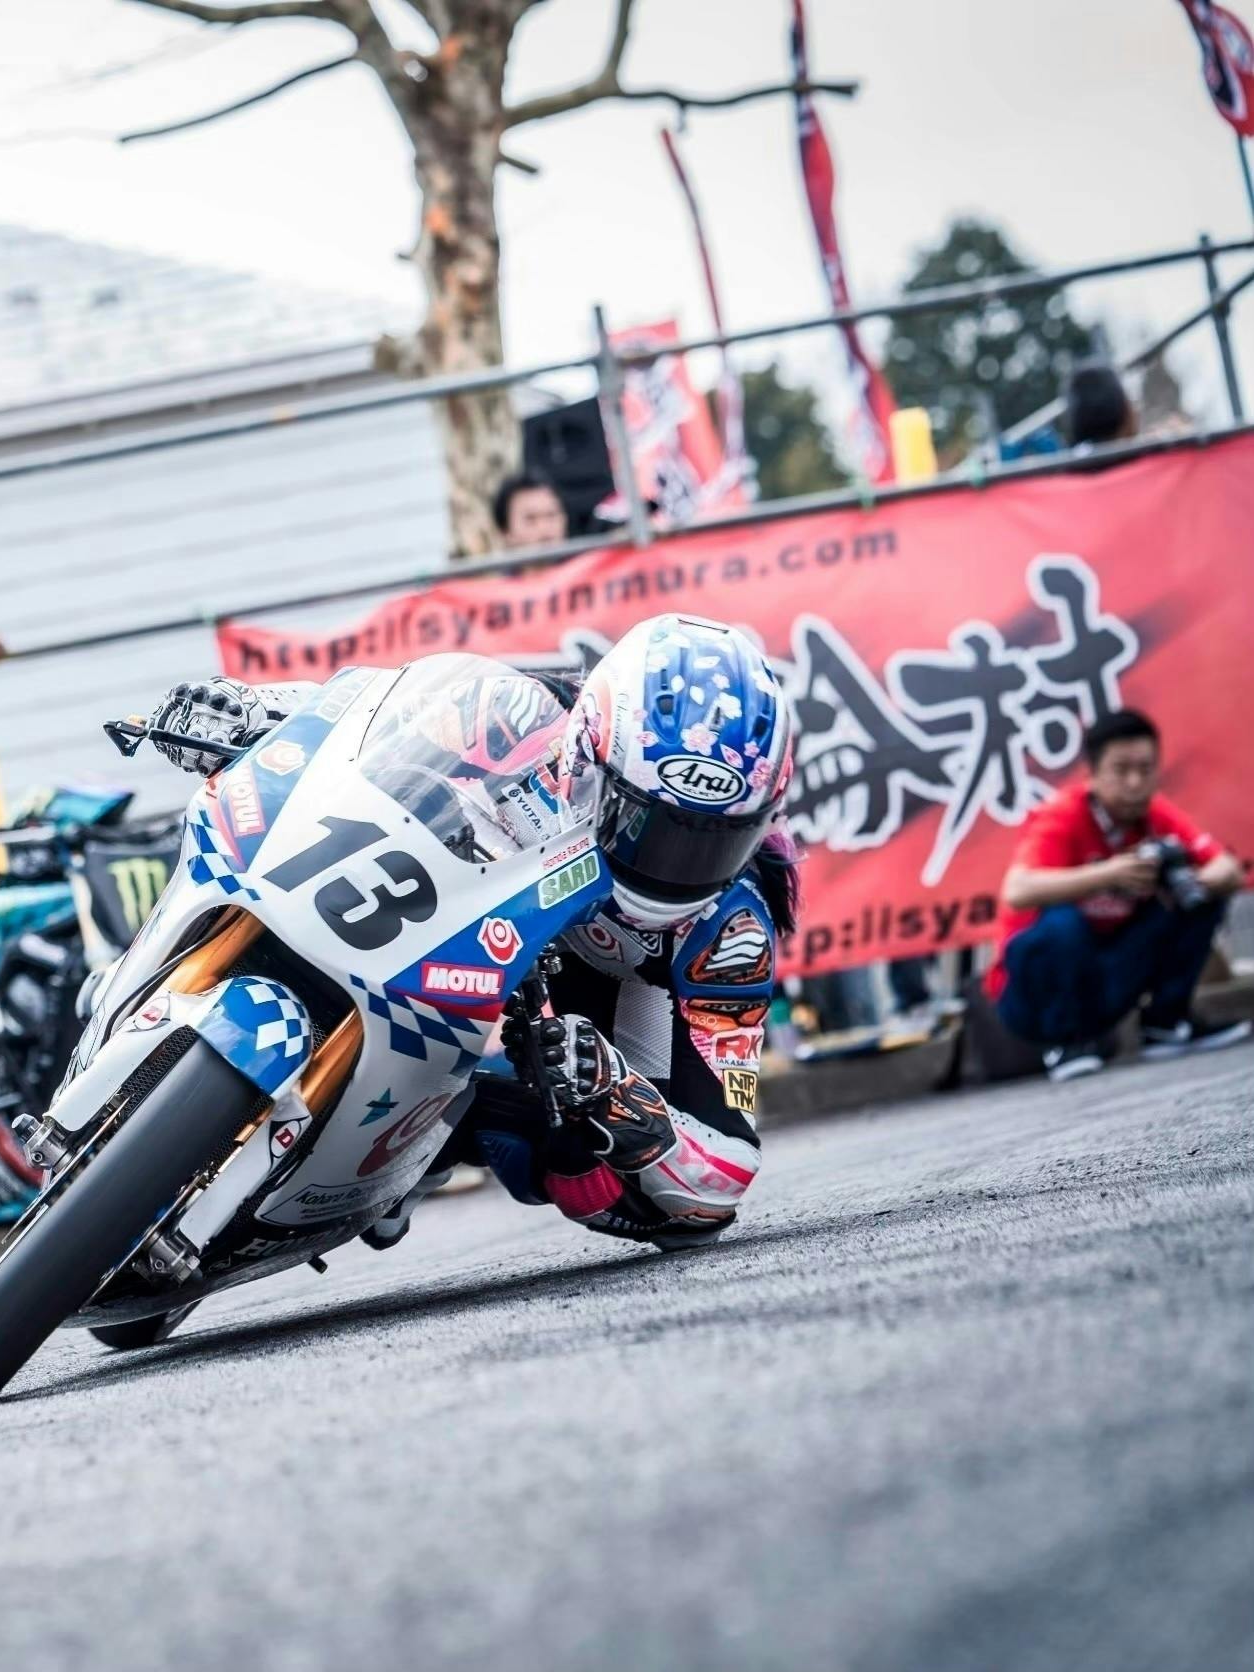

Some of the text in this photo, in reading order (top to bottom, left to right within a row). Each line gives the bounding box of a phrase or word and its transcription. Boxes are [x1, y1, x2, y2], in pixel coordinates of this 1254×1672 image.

[662, 763, 735, 793] Arai
[261, 816, 437, 951] 13
[542, 855, 598, 906] SARD
[425, 967, 500, 995] MOTUL
[716, 1034, 763, 1060] RK
